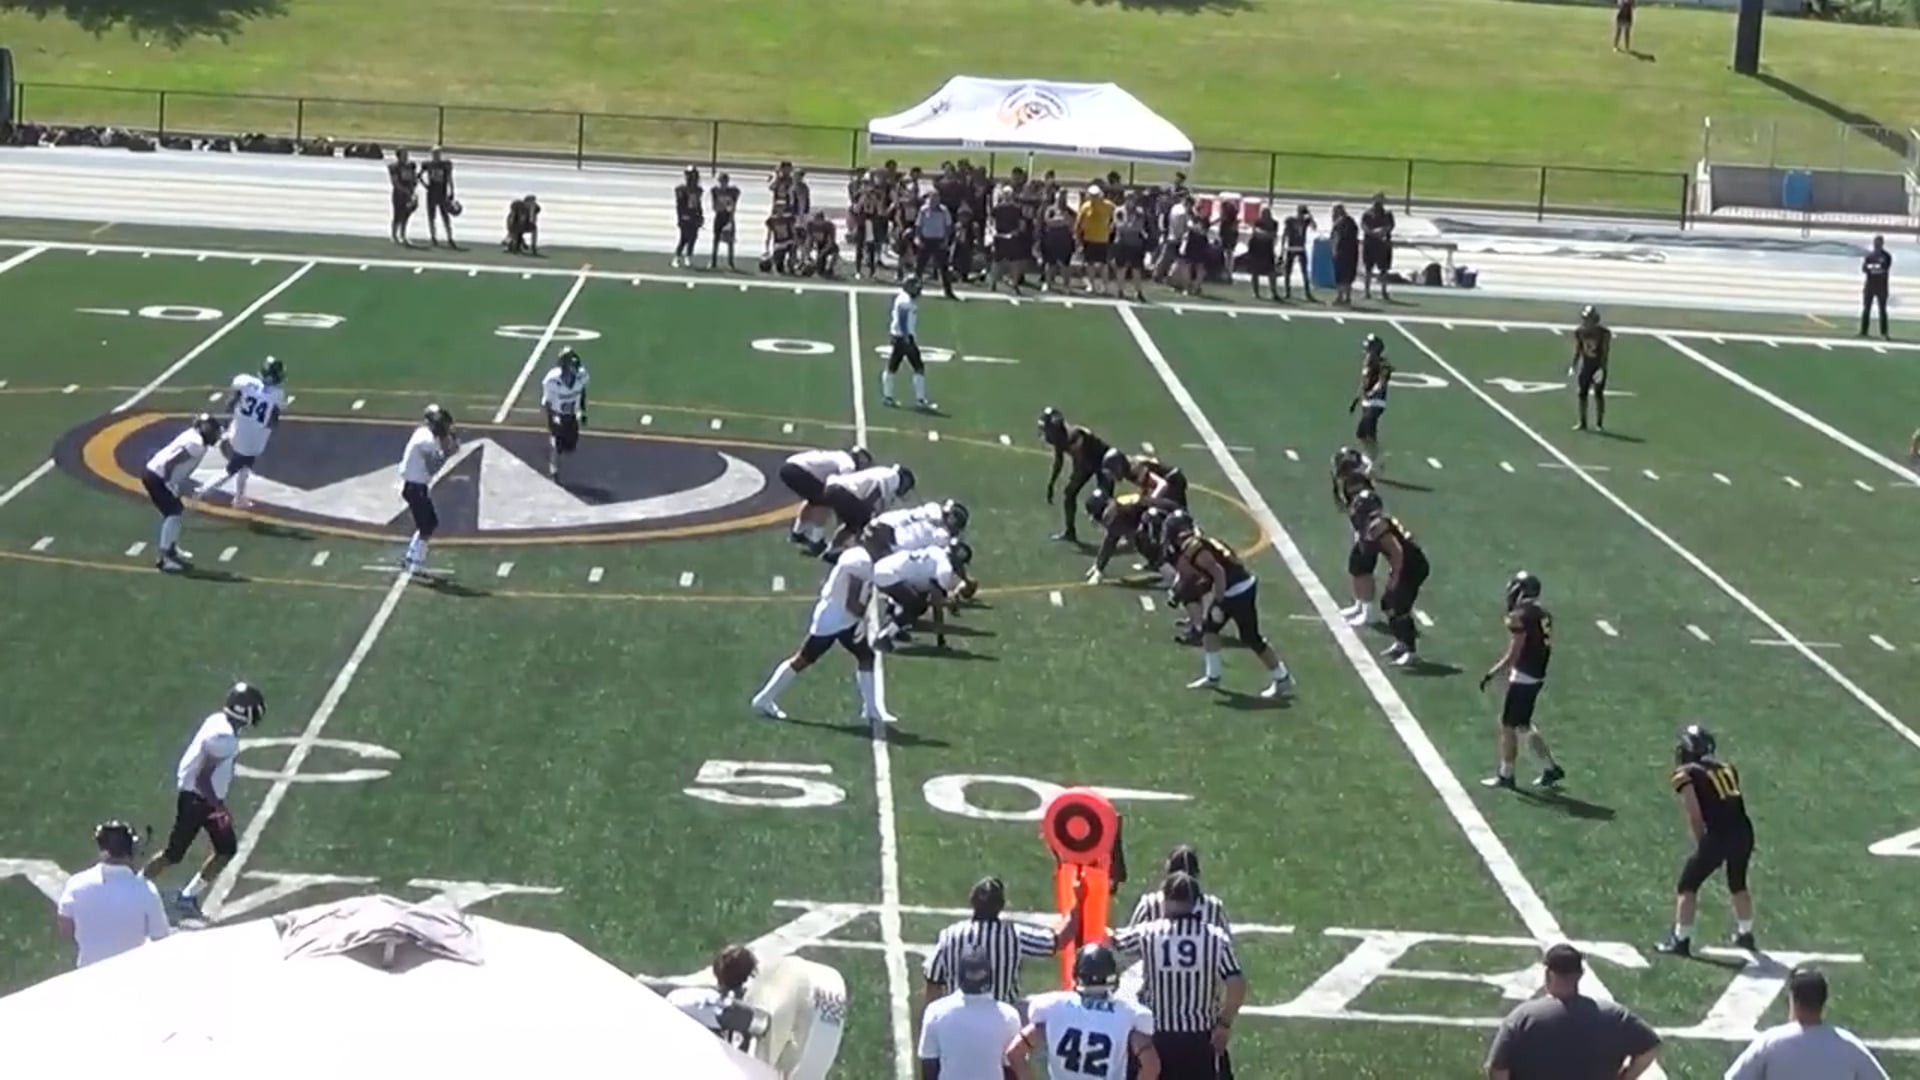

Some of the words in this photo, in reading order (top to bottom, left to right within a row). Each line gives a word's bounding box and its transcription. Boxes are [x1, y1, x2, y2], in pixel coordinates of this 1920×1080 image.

[241, 396, 267, 423] 34
[1706, 766, 1741, 799] 10
[1162, 938, 1198, 967] 19
[1056, 1027, 1112, 1077] 42
